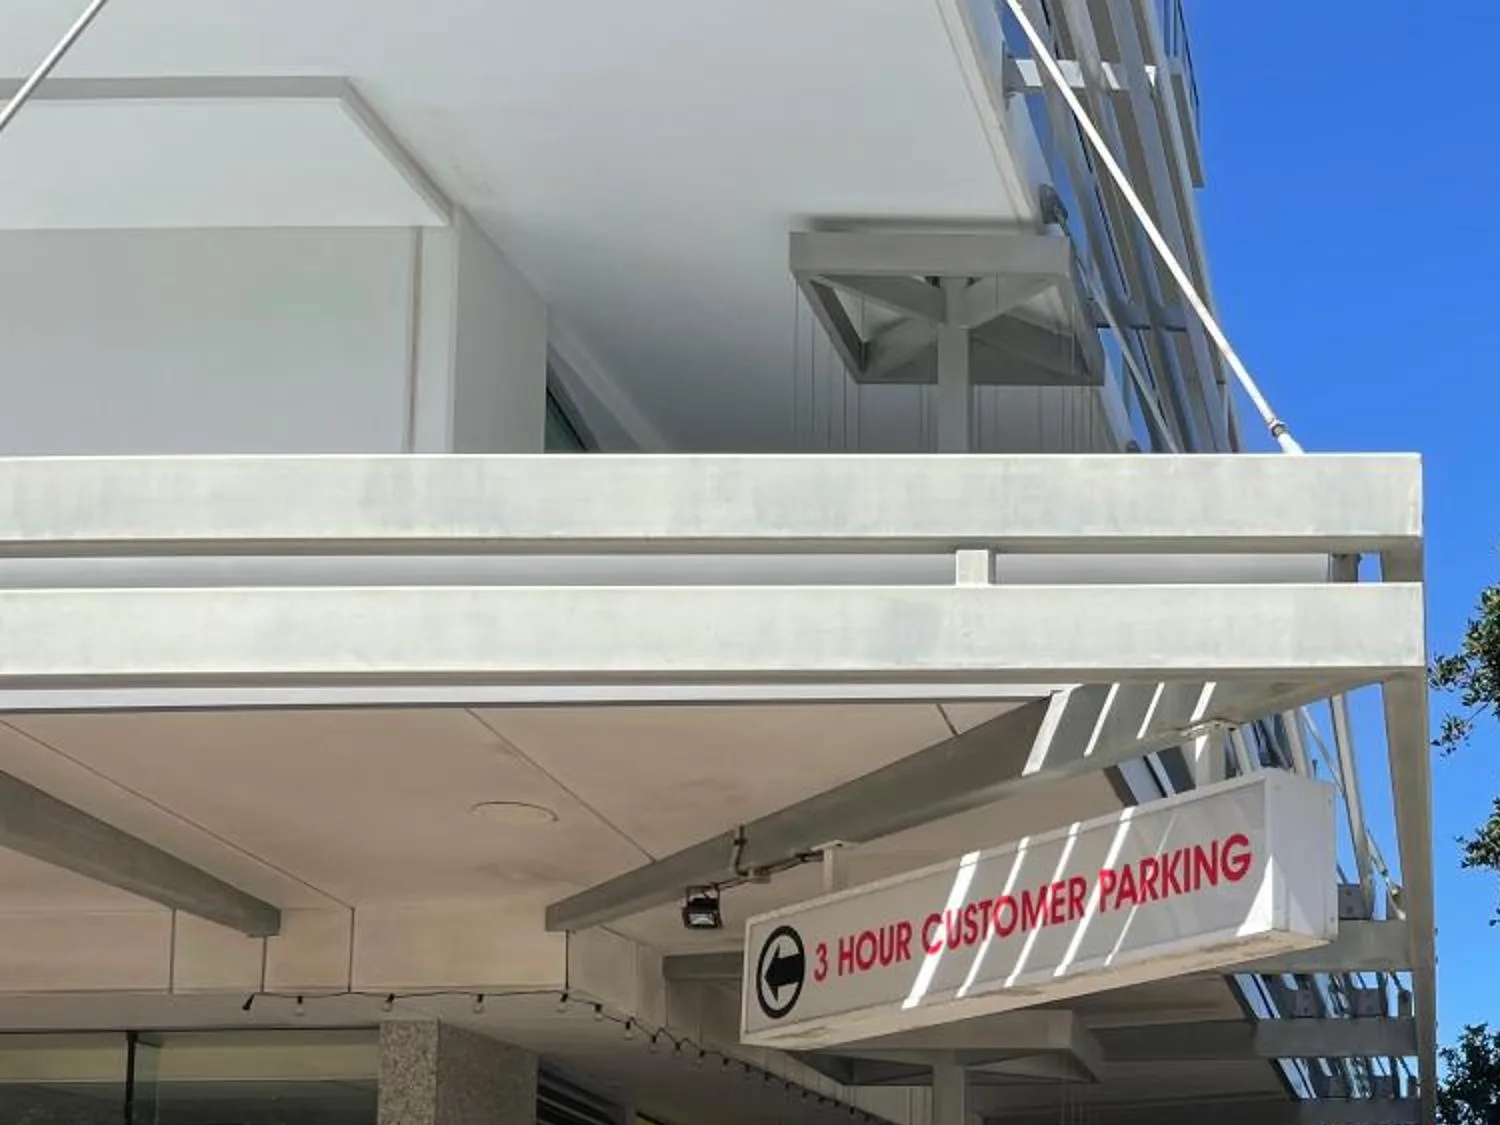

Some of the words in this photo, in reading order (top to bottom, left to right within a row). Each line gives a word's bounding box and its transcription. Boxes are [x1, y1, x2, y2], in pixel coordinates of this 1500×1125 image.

[813, 942, 829, 982] 3
[837, 920, 912, 975] HOUR
[921, 875, 1087, 956] CUSTOMER
[1098, 832, 1254, 914] PARKING
